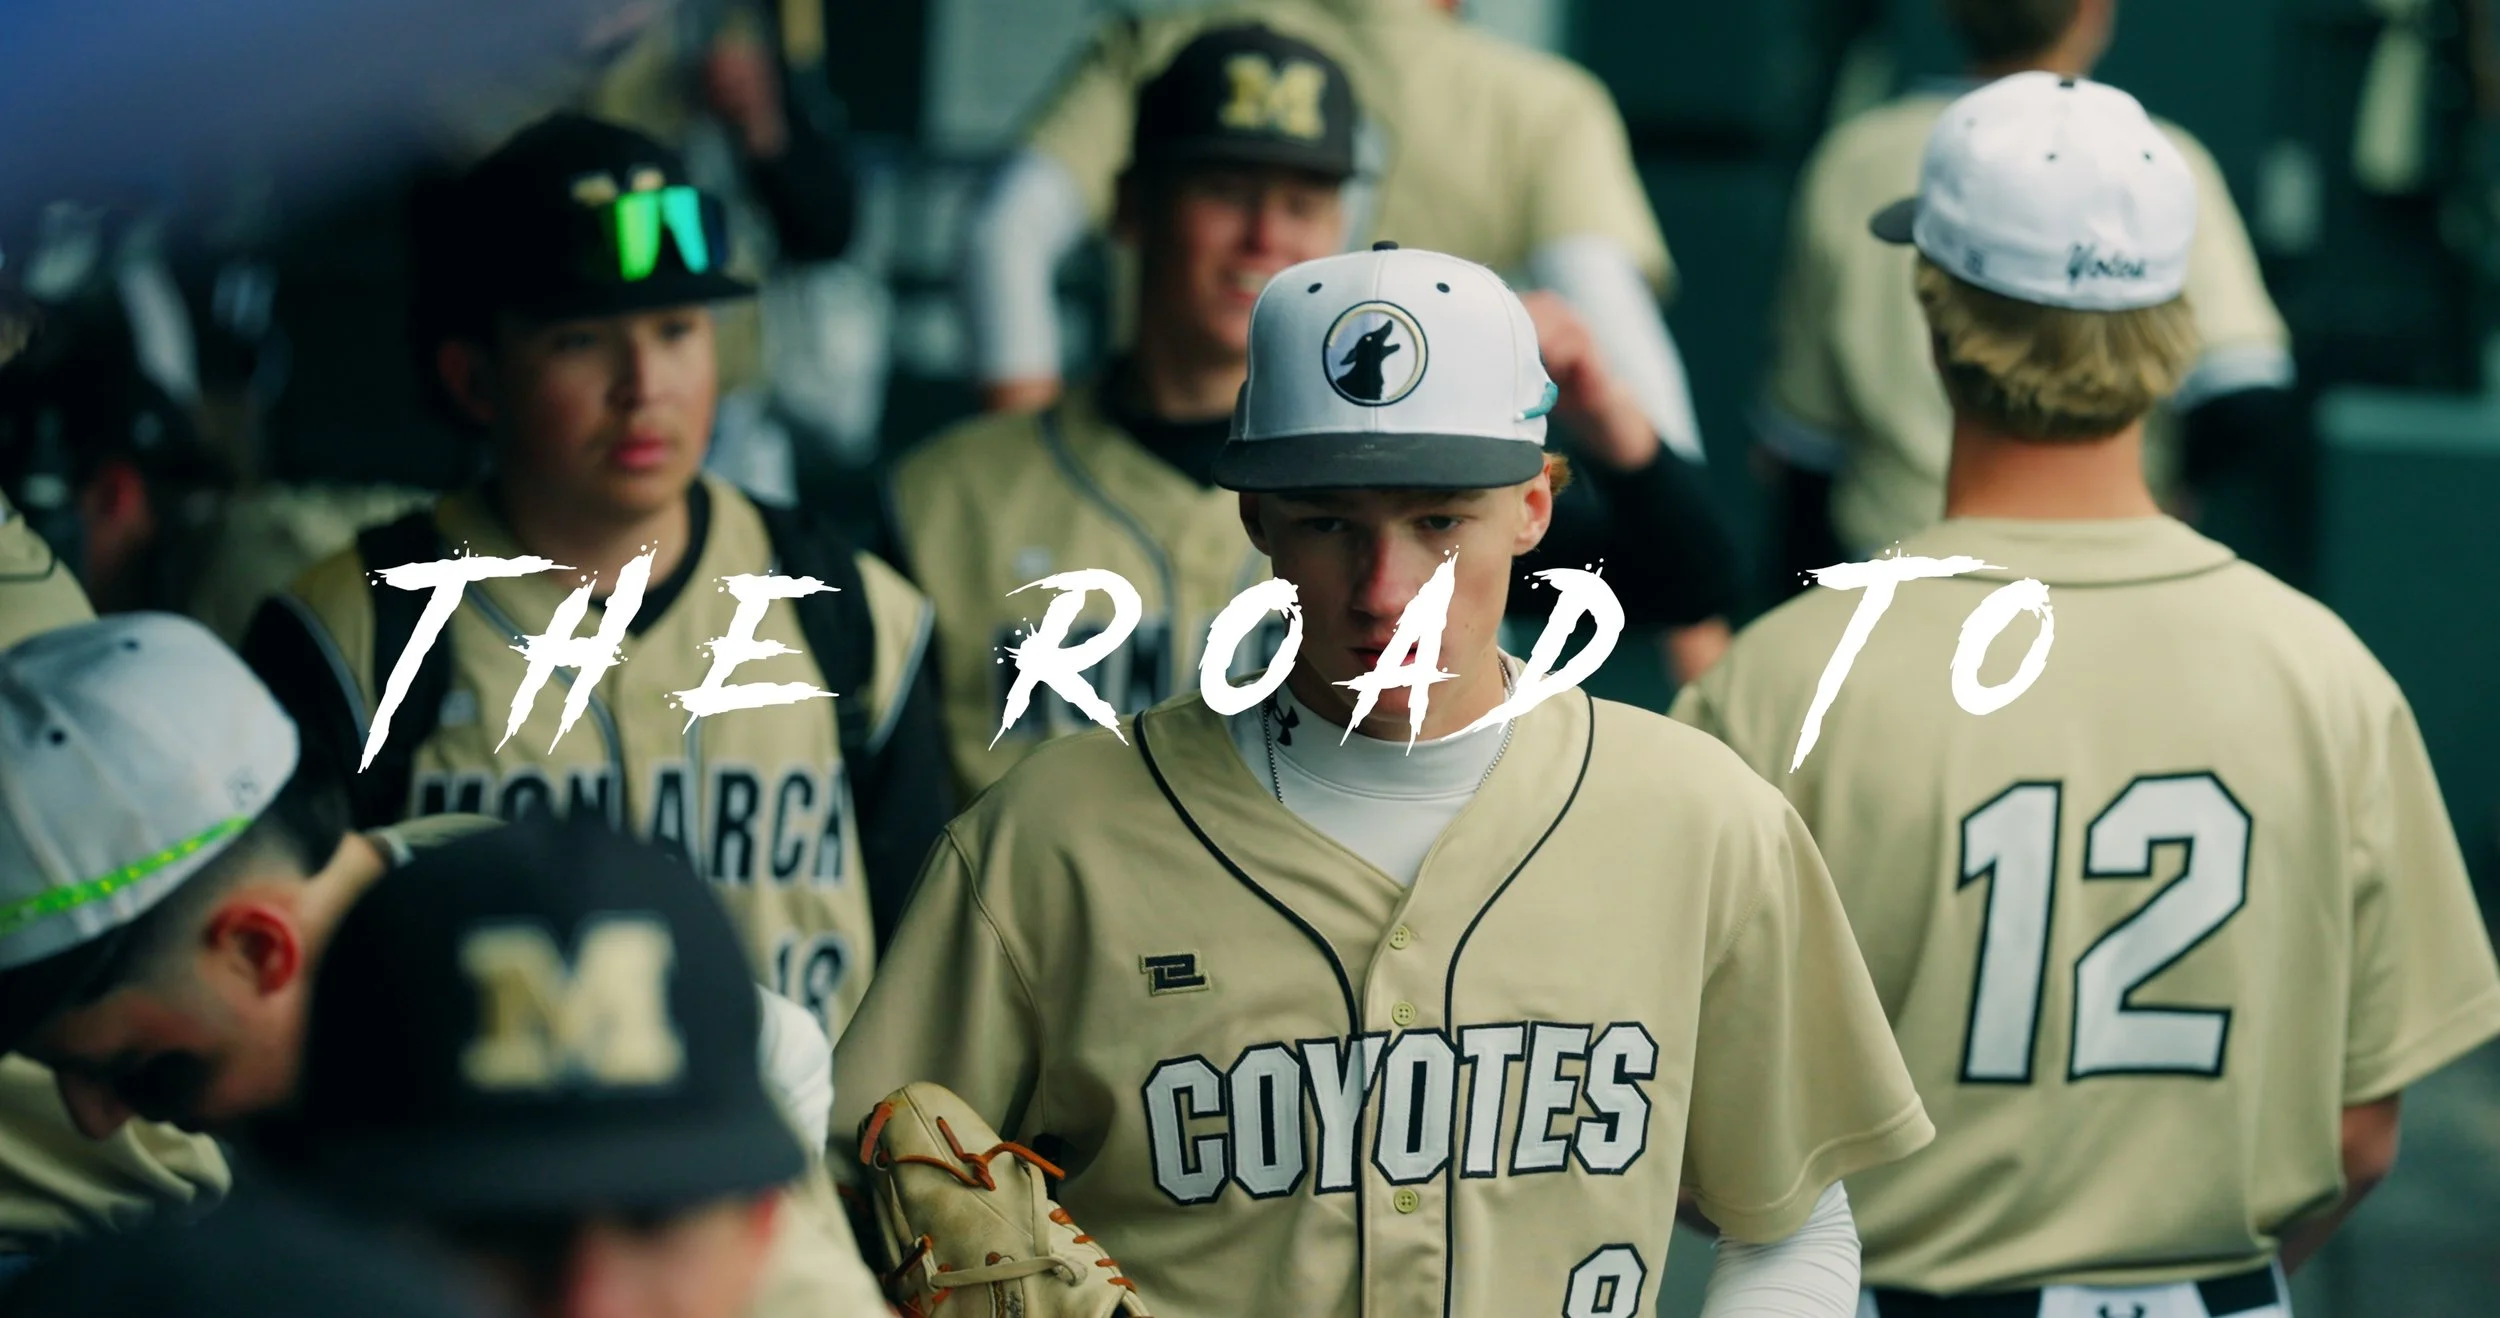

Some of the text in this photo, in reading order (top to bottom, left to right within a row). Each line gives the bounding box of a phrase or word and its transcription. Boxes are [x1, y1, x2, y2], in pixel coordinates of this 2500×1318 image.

[1221, 52, 1328, 142] M
[457, 914, 688, 1092] M
[1955, 769, 2254, 1085] 12
[1142, 1021, 1660, 1206] COYOTES
